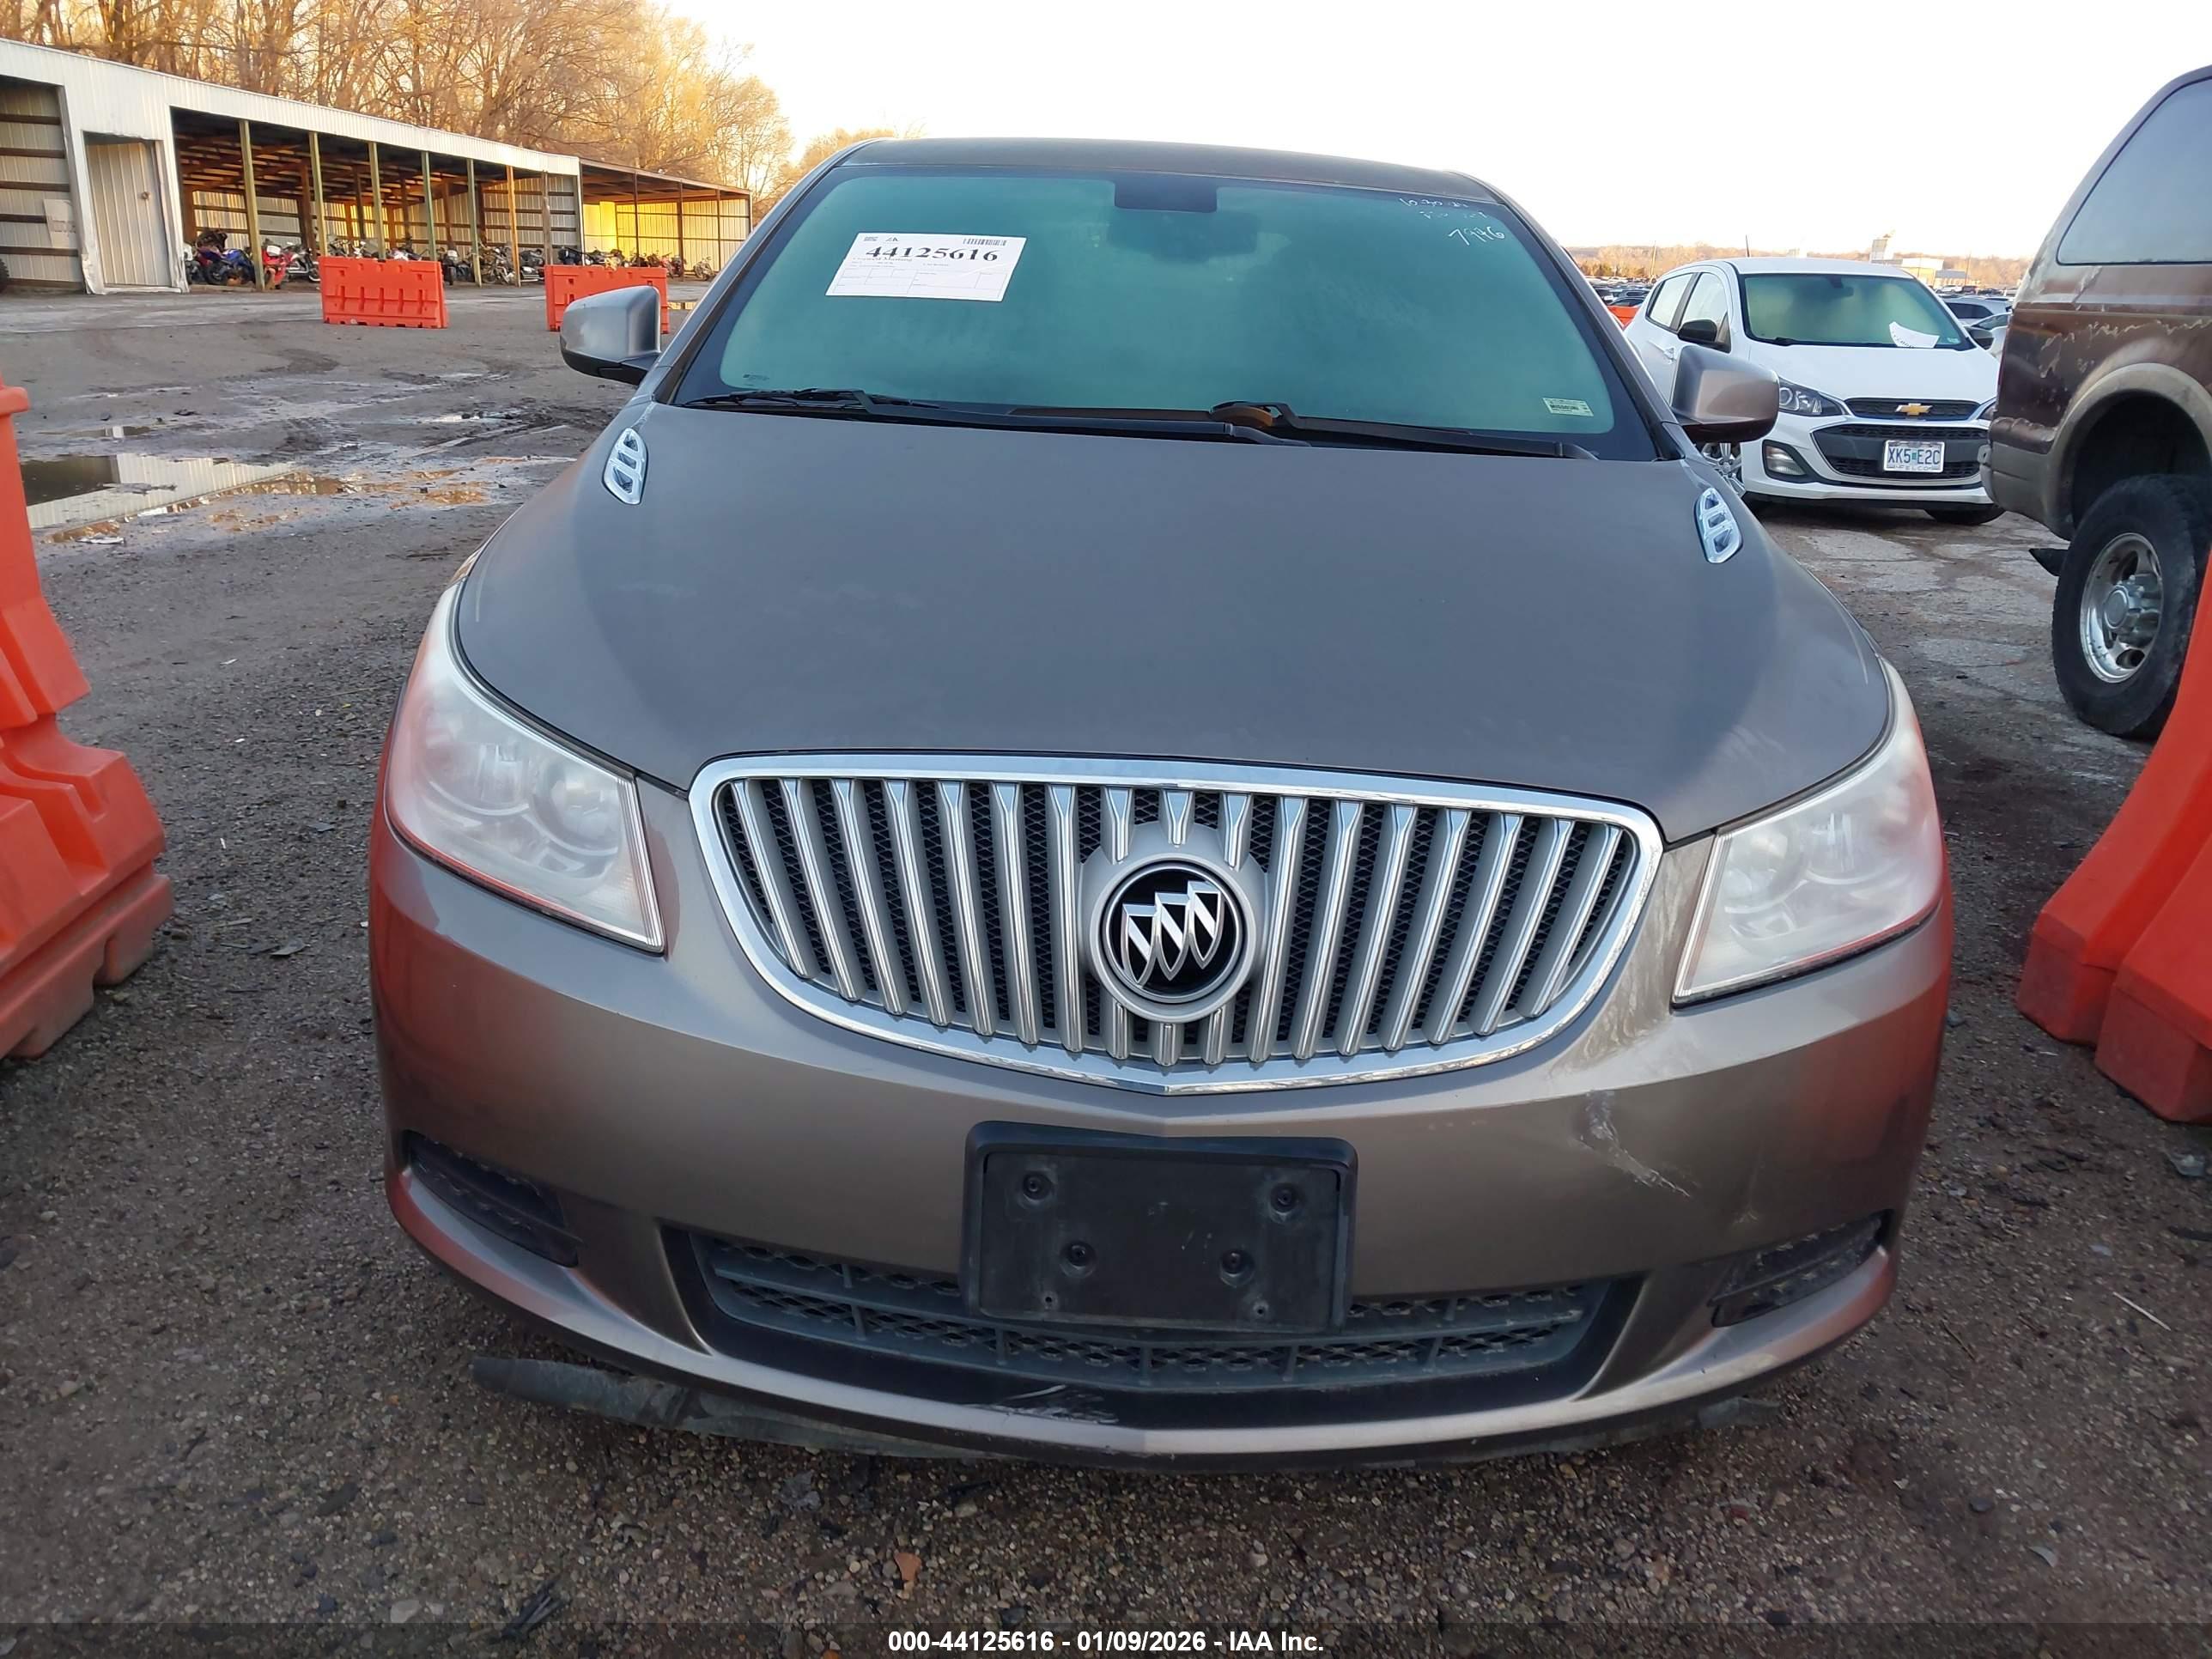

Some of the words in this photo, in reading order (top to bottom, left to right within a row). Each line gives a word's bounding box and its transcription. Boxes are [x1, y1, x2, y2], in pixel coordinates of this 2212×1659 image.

[865, 246, 1000, 262] 44125616
[1888, 447, 1911, 464] XK5
[1917, 448, 1941, 465] E2C
